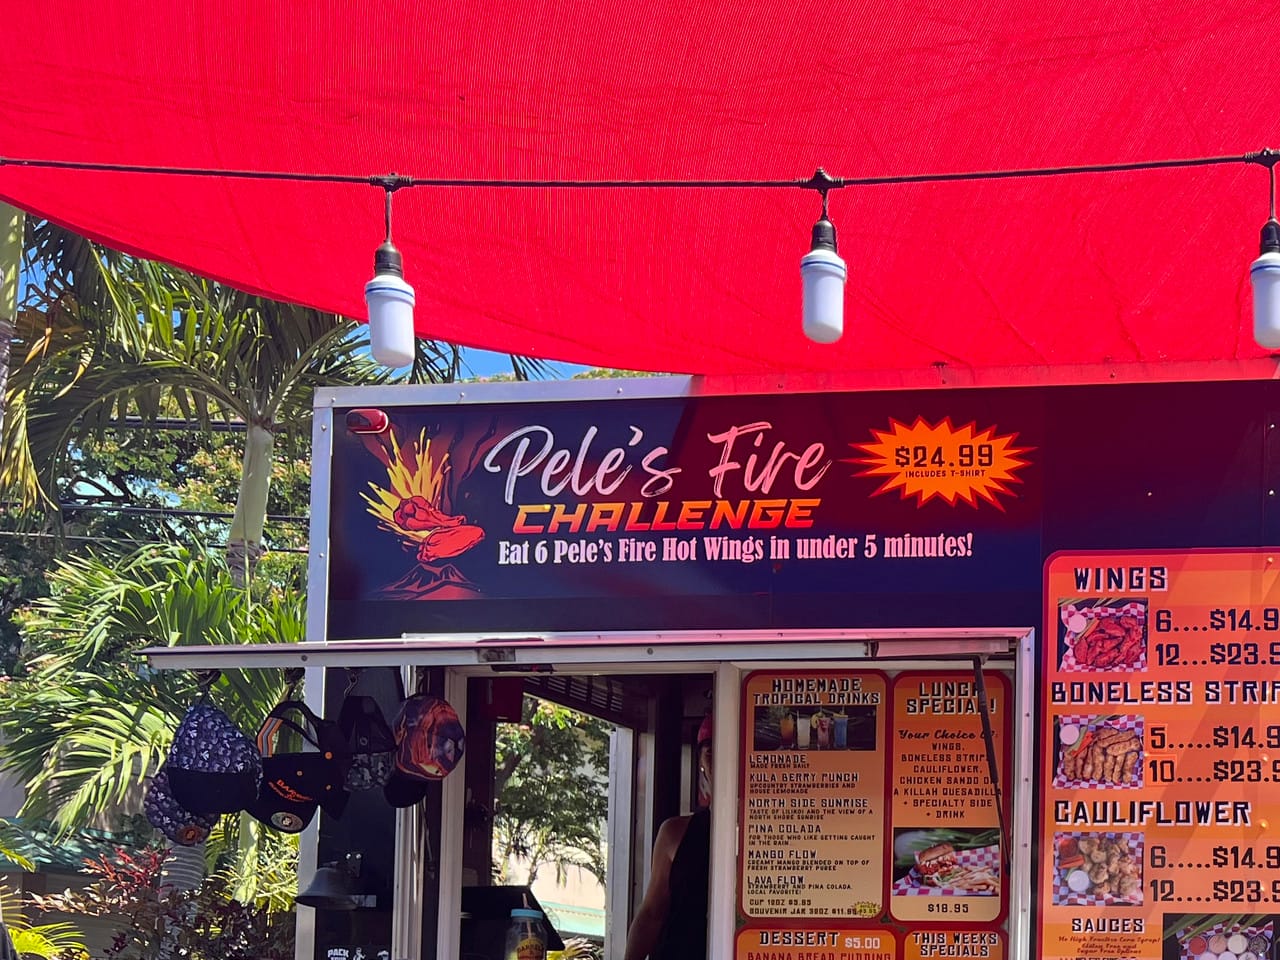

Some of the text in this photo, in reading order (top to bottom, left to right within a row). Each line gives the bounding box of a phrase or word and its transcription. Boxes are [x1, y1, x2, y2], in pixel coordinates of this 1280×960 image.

[893, 443, 995, 468] $24.99
[484, 421, 834, 505] Pele's Fire
[905, 468, 987, 479] INCLUDES T-SHIRT
[512, 499, 822, 534] CHALLENGE
[498, 532, 974, 565] Eat 6 Pele's Fire Hot Wings in under 5 minutes!
[1073, 566, 1169, 593] WINGS
[771, 678, 863, 694] HOMEMADE
[1051, 680, 1193, 705] BONELESS
[753, 692, 881, 706] TROPICAL DRINKS
[749, 754, 807, 764] LEMONADE
[749, 772, 859, 783] KULA BERRY PUNCH
[748, 798, 869, 808] NORTH SIDE SUNRISE
[913, 798, 992, 807] SPECIALTY SIDE
[935, 810, 965, 819] DRINK
[1054, 800, 1252, 827] CAULIFLOWER
[927, 903, 969, 914] $18.95
[1071, 918, 1145, 934] SAUCES
[760, 931, 881, 949] DESSERT $5.00
[912, 932, 999, 946] THIS WEEKS
[327, 948, 350, 958] PACK
[920, 944, 990, 958] SPECIALS
